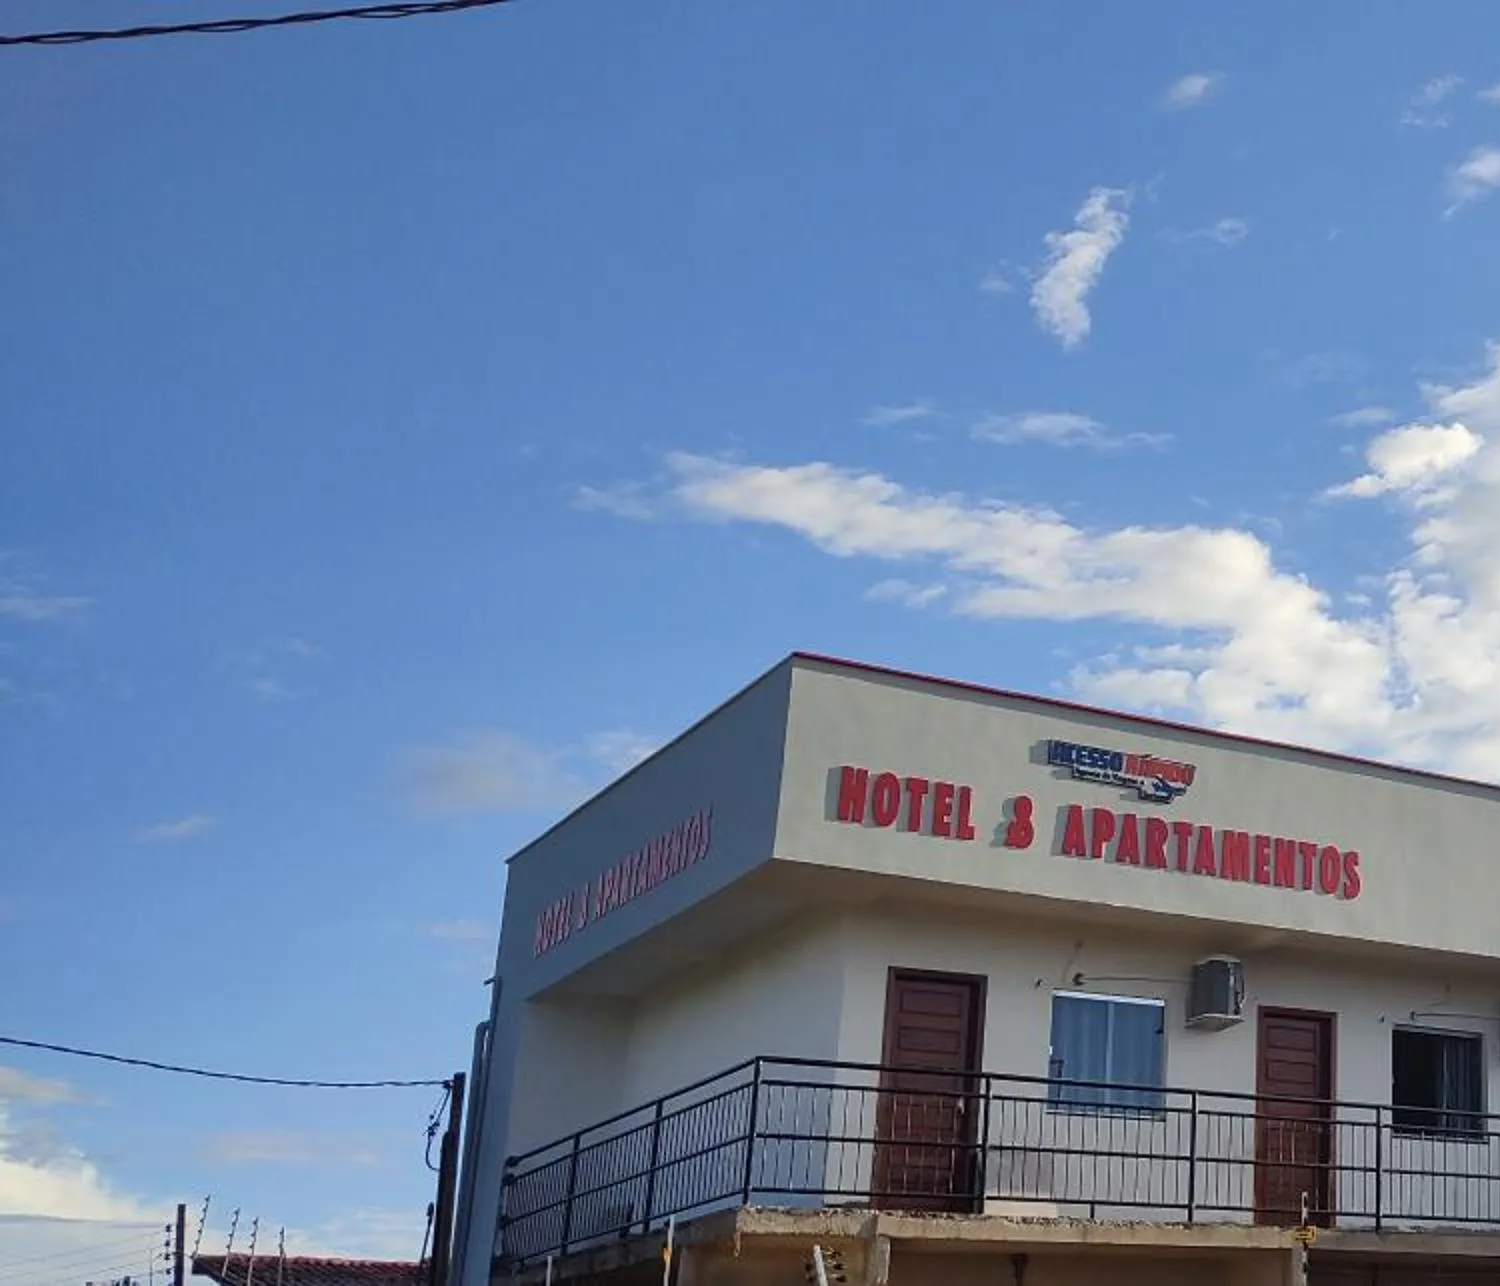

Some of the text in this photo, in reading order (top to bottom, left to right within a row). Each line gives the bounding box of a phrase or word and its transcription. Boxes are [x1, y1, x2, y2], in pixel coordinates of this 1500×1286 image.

[838, 765, 1361, 900] HOTEL & APARTAMENTOS
